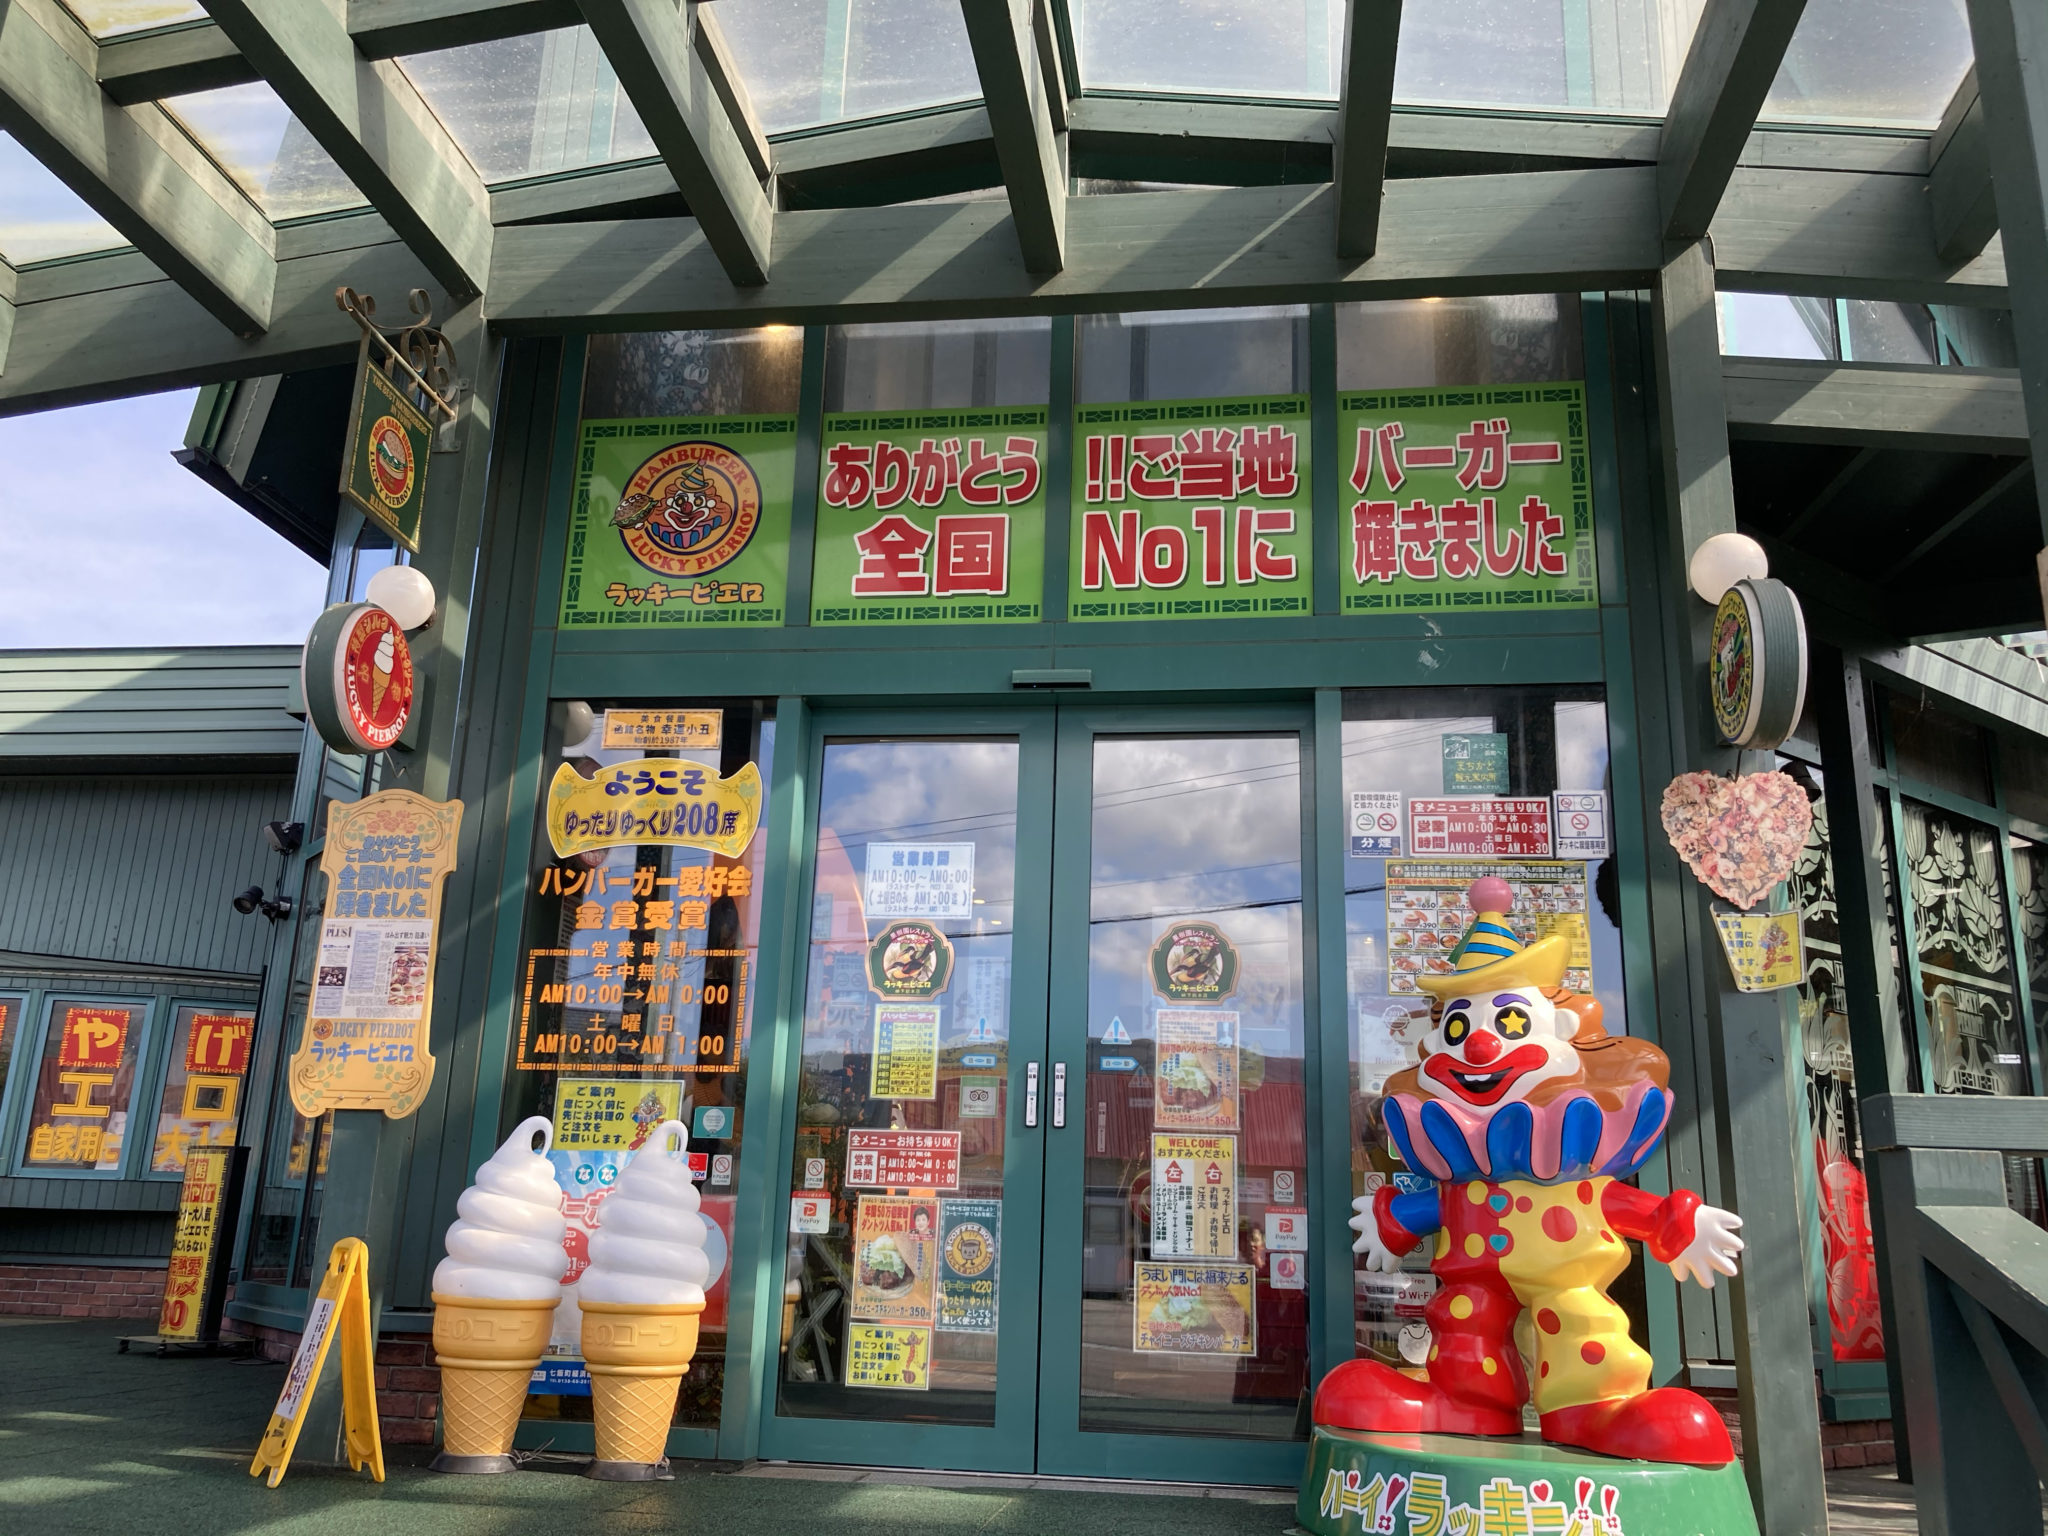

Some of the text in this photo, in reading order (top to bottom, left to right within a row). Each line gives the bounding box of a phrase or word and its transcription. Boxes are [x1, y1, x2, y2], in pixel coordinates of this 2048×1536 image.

[1349, 416, 1562, 494] バーガー
[634, 447, 749, 492] HAMBURGER
[823, 436, 1040, 511] ありがとう
[370, 451, 384, 493] LUCKY
[384, 485, 411, 506] PIERROT
[630, 500, 756, 572] LUCKY PIERROT
[1352, 496, 1567, 585] 輝きました
[851, 513, 1009, 597] 全国
[1081, 506, 1296, 590] No1に
[605, 580, 764, 607] ラッキーピエロ
[348, 664, 367, 727] LUCKY
[367, 707, 408, 742] PIERROT
[605, 770, 706, 796] ようこそ
[1418, 820, 1445, 833] 営業
[1479, 814, 1518, 823] 年中無休
[363, 835, 420, 849] ありがとう
[1361, 837, 1392, 848] 分煙
[1418, 836, 1445, 848] 時間
[1485, 834, 1513, 842] 土曜日
[892, 851, 950, 866] 営業時間
[337, 864, 432, 891] 全国No1に
[539, 865, 753, 897] ハンバーガー愛好会
[335, 891, 426, 918] 輝きました
[575, 900, 709, 931] 金賞受賞
[591, 941, 687, 958] 営業時間
[593, 963, 680, 981] 年中無休
[332, 1022, 416, 1039] LUCKY PIERROT
[587, 1013, 675, 1033] 土曜日
[73, 1017, 246, 1065] や げ
[310, 1040, 415, 1063] ラッキーピエロ
[576, 1086, 616, 1097] ご案内
[564, 1099, 625, 1110] 席につく前に
[562, 1110, 624, 1121] 先にお料理の
[561, 1121, 602, 1132] ご注文を
[559, 1133, 627, 1144] お願いします。
[1168, 1137, 1220, 1149] WELCOME
[854, 1154, 873, 1166] 営業
[1157, 1147, 1231, 1159] おすすみください
[853, 1169, 872, 1180] 時間
[1168, 1167, 1221, 1180] 左 右
[1197, 1186, 1206, 1210] ご注文
[1222, 1187, 1231, 1234] ラッキーピエロ
[1275, 1234, 1298, 1242] PayPay
[1140, 1267, 1249, 1287] うまい門には福来たる
[1408, 1291, 1433, 1300] Wi-Fi
[865, 1330, 894, 1339] ご案内
[1140, 1332, 1249, 1349] チャイニーズチキンバーガー
